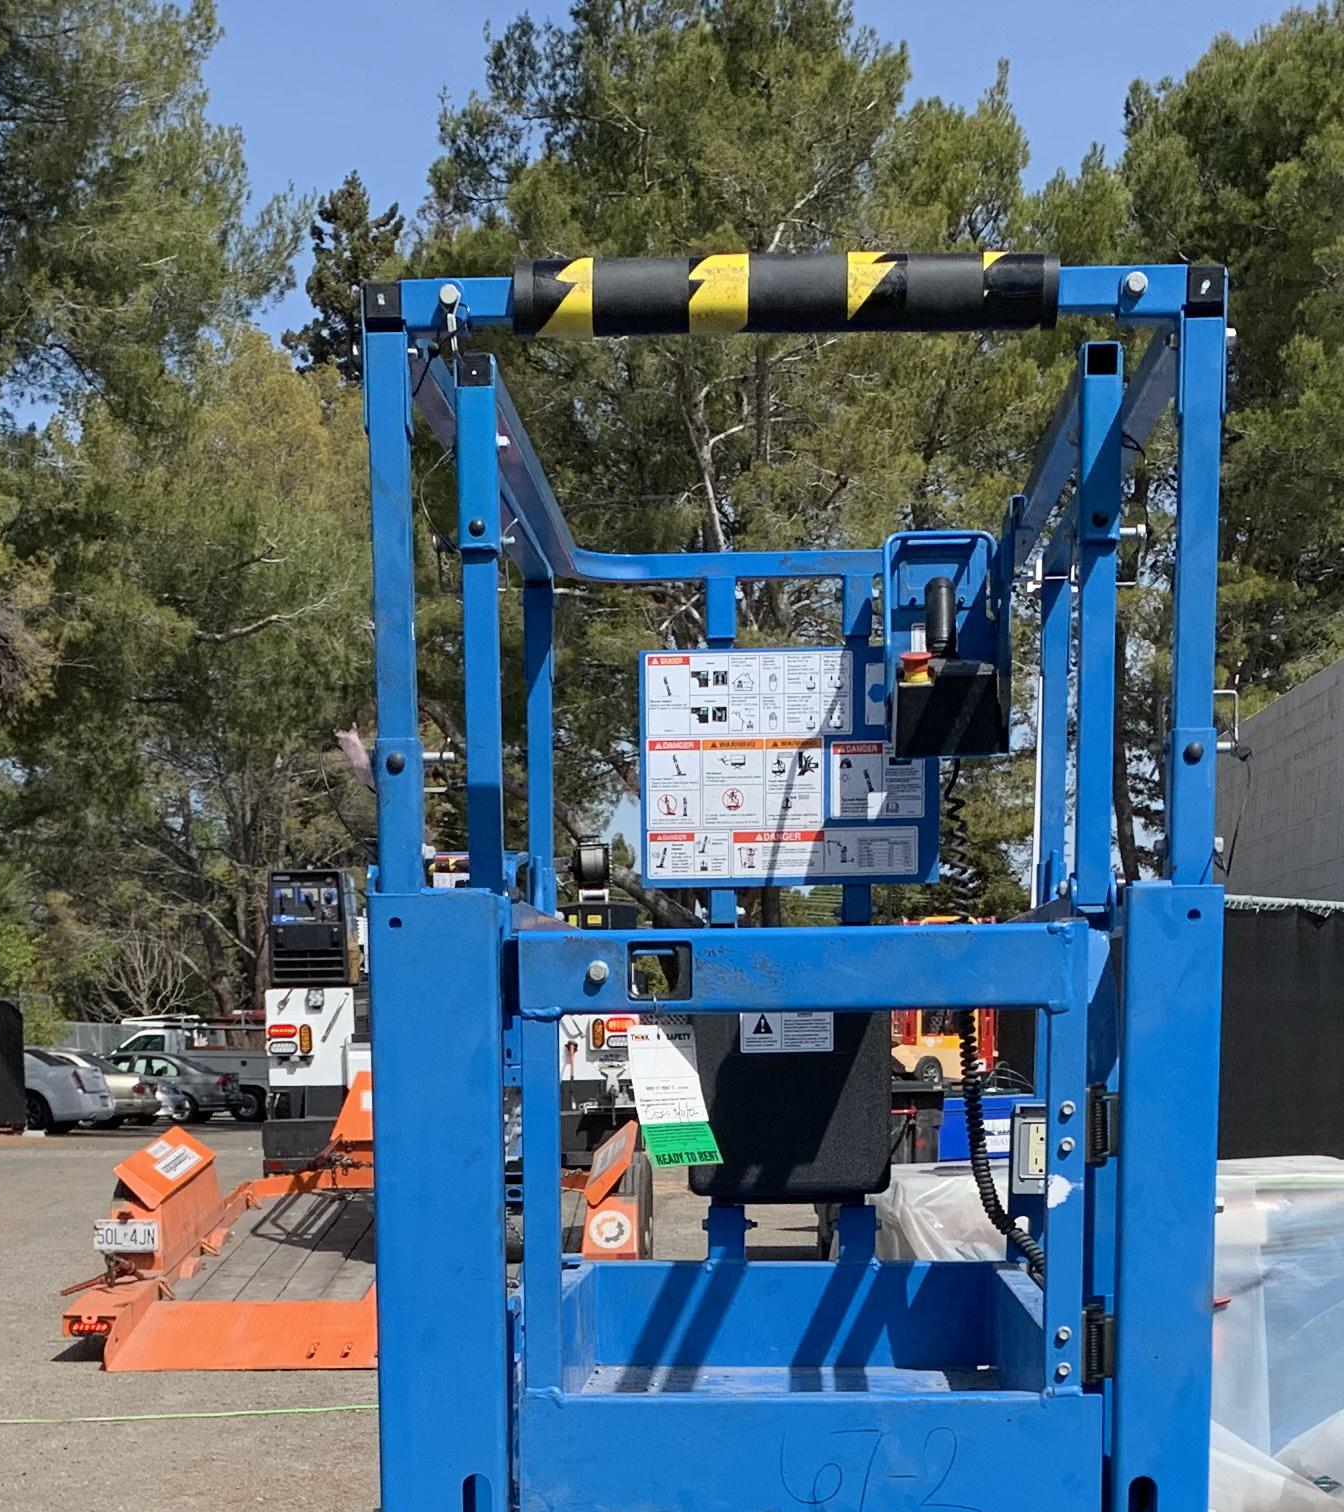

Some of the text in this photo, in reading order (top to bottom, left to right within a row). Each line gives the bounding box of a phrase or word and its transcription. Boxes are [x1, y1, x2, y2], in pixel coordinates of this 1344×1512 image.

[662, 741, 695, 750] DANGER
[719, 741, 756, 749] WARNING
[846, 743, 878, 754] DANGER
[762, 831, 801, 842] DANGER
[655, 1150, 721, 1166] READY TO RENT
[130, 1228, 155, 1245] 4JN
